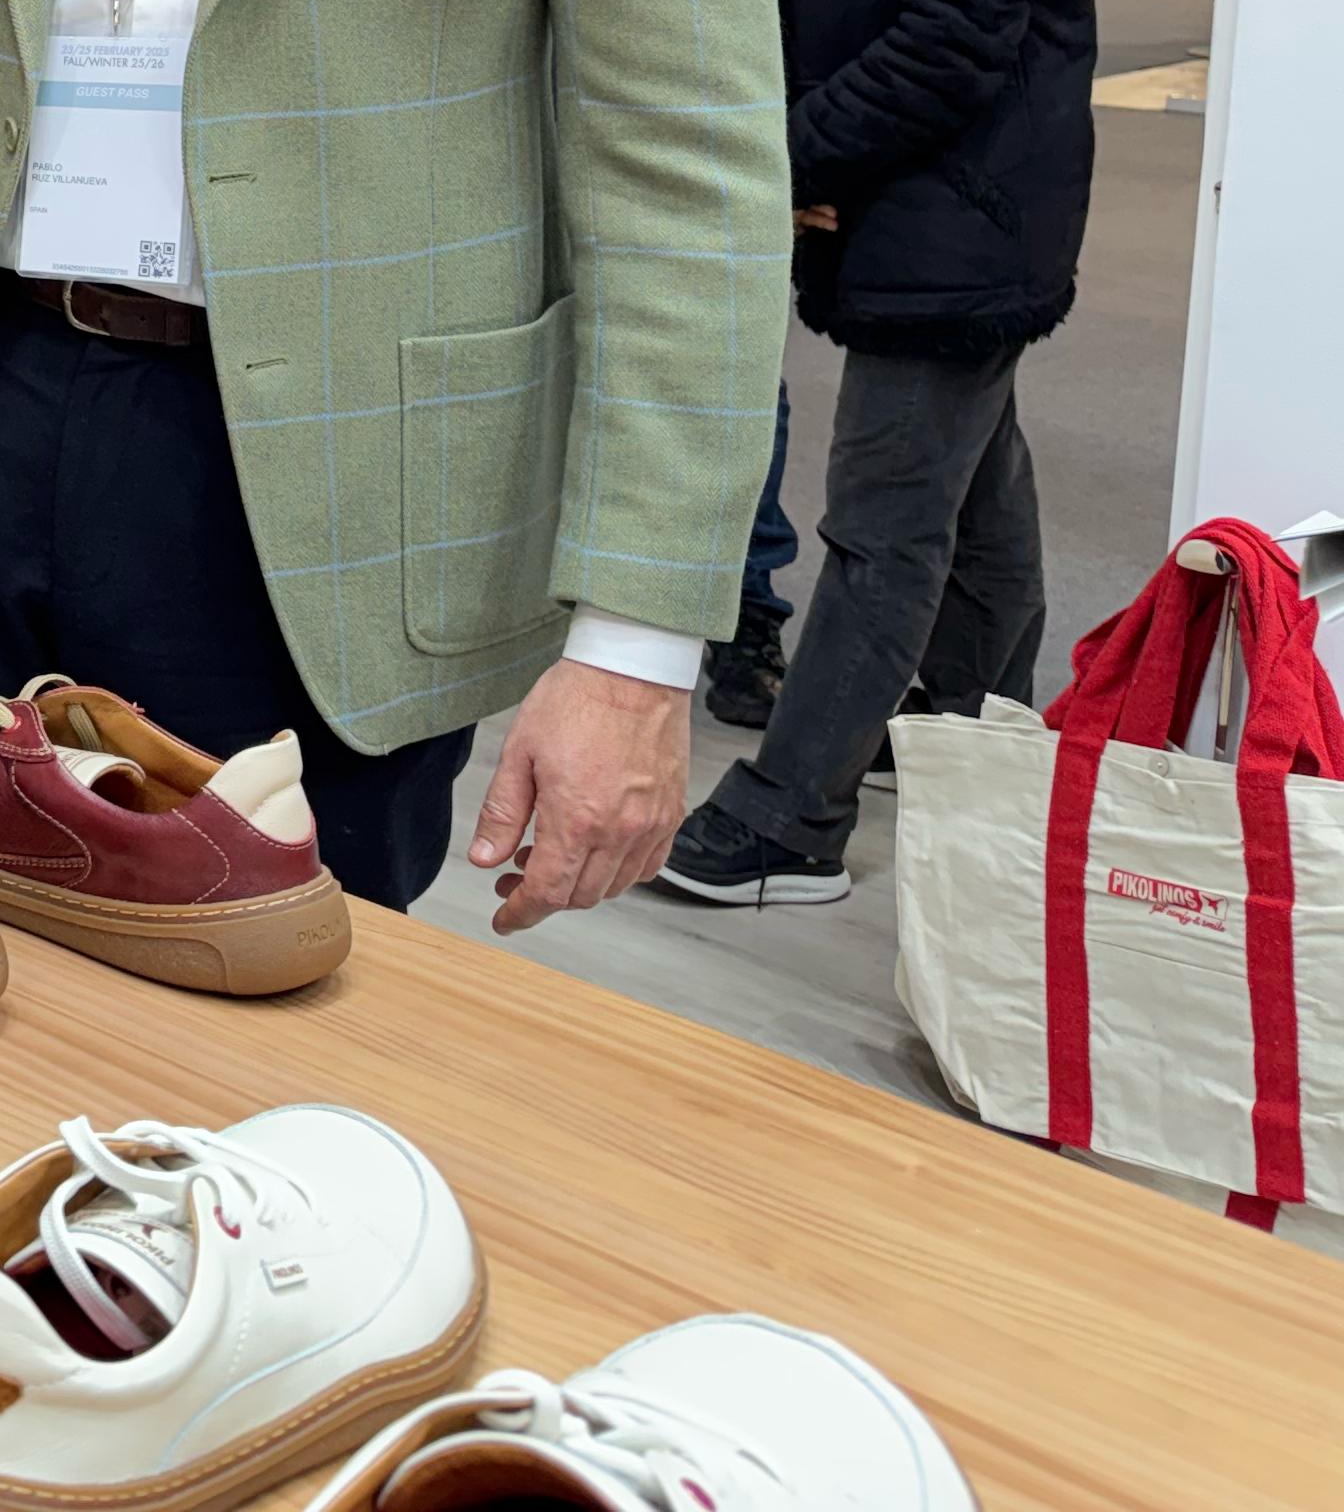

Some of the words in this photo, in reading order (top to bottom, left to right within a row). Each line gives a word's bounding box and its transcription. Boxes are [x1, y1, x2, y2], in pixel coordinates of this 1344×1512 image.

[93, 45, 143, 57] FEBRUARY
[63, 56, 128, 68] FALL/WINTER
[131, 58, 165, 70] 25/26
[76, 86, 115, 97] GUEST
[117, 88, 150, 98] PASS
[32, 162, 63, 172] PABLO
[53, 174, 108, 186] VILLANUEVA
[1113, 871, 1198, 909] PIKOLINOS
